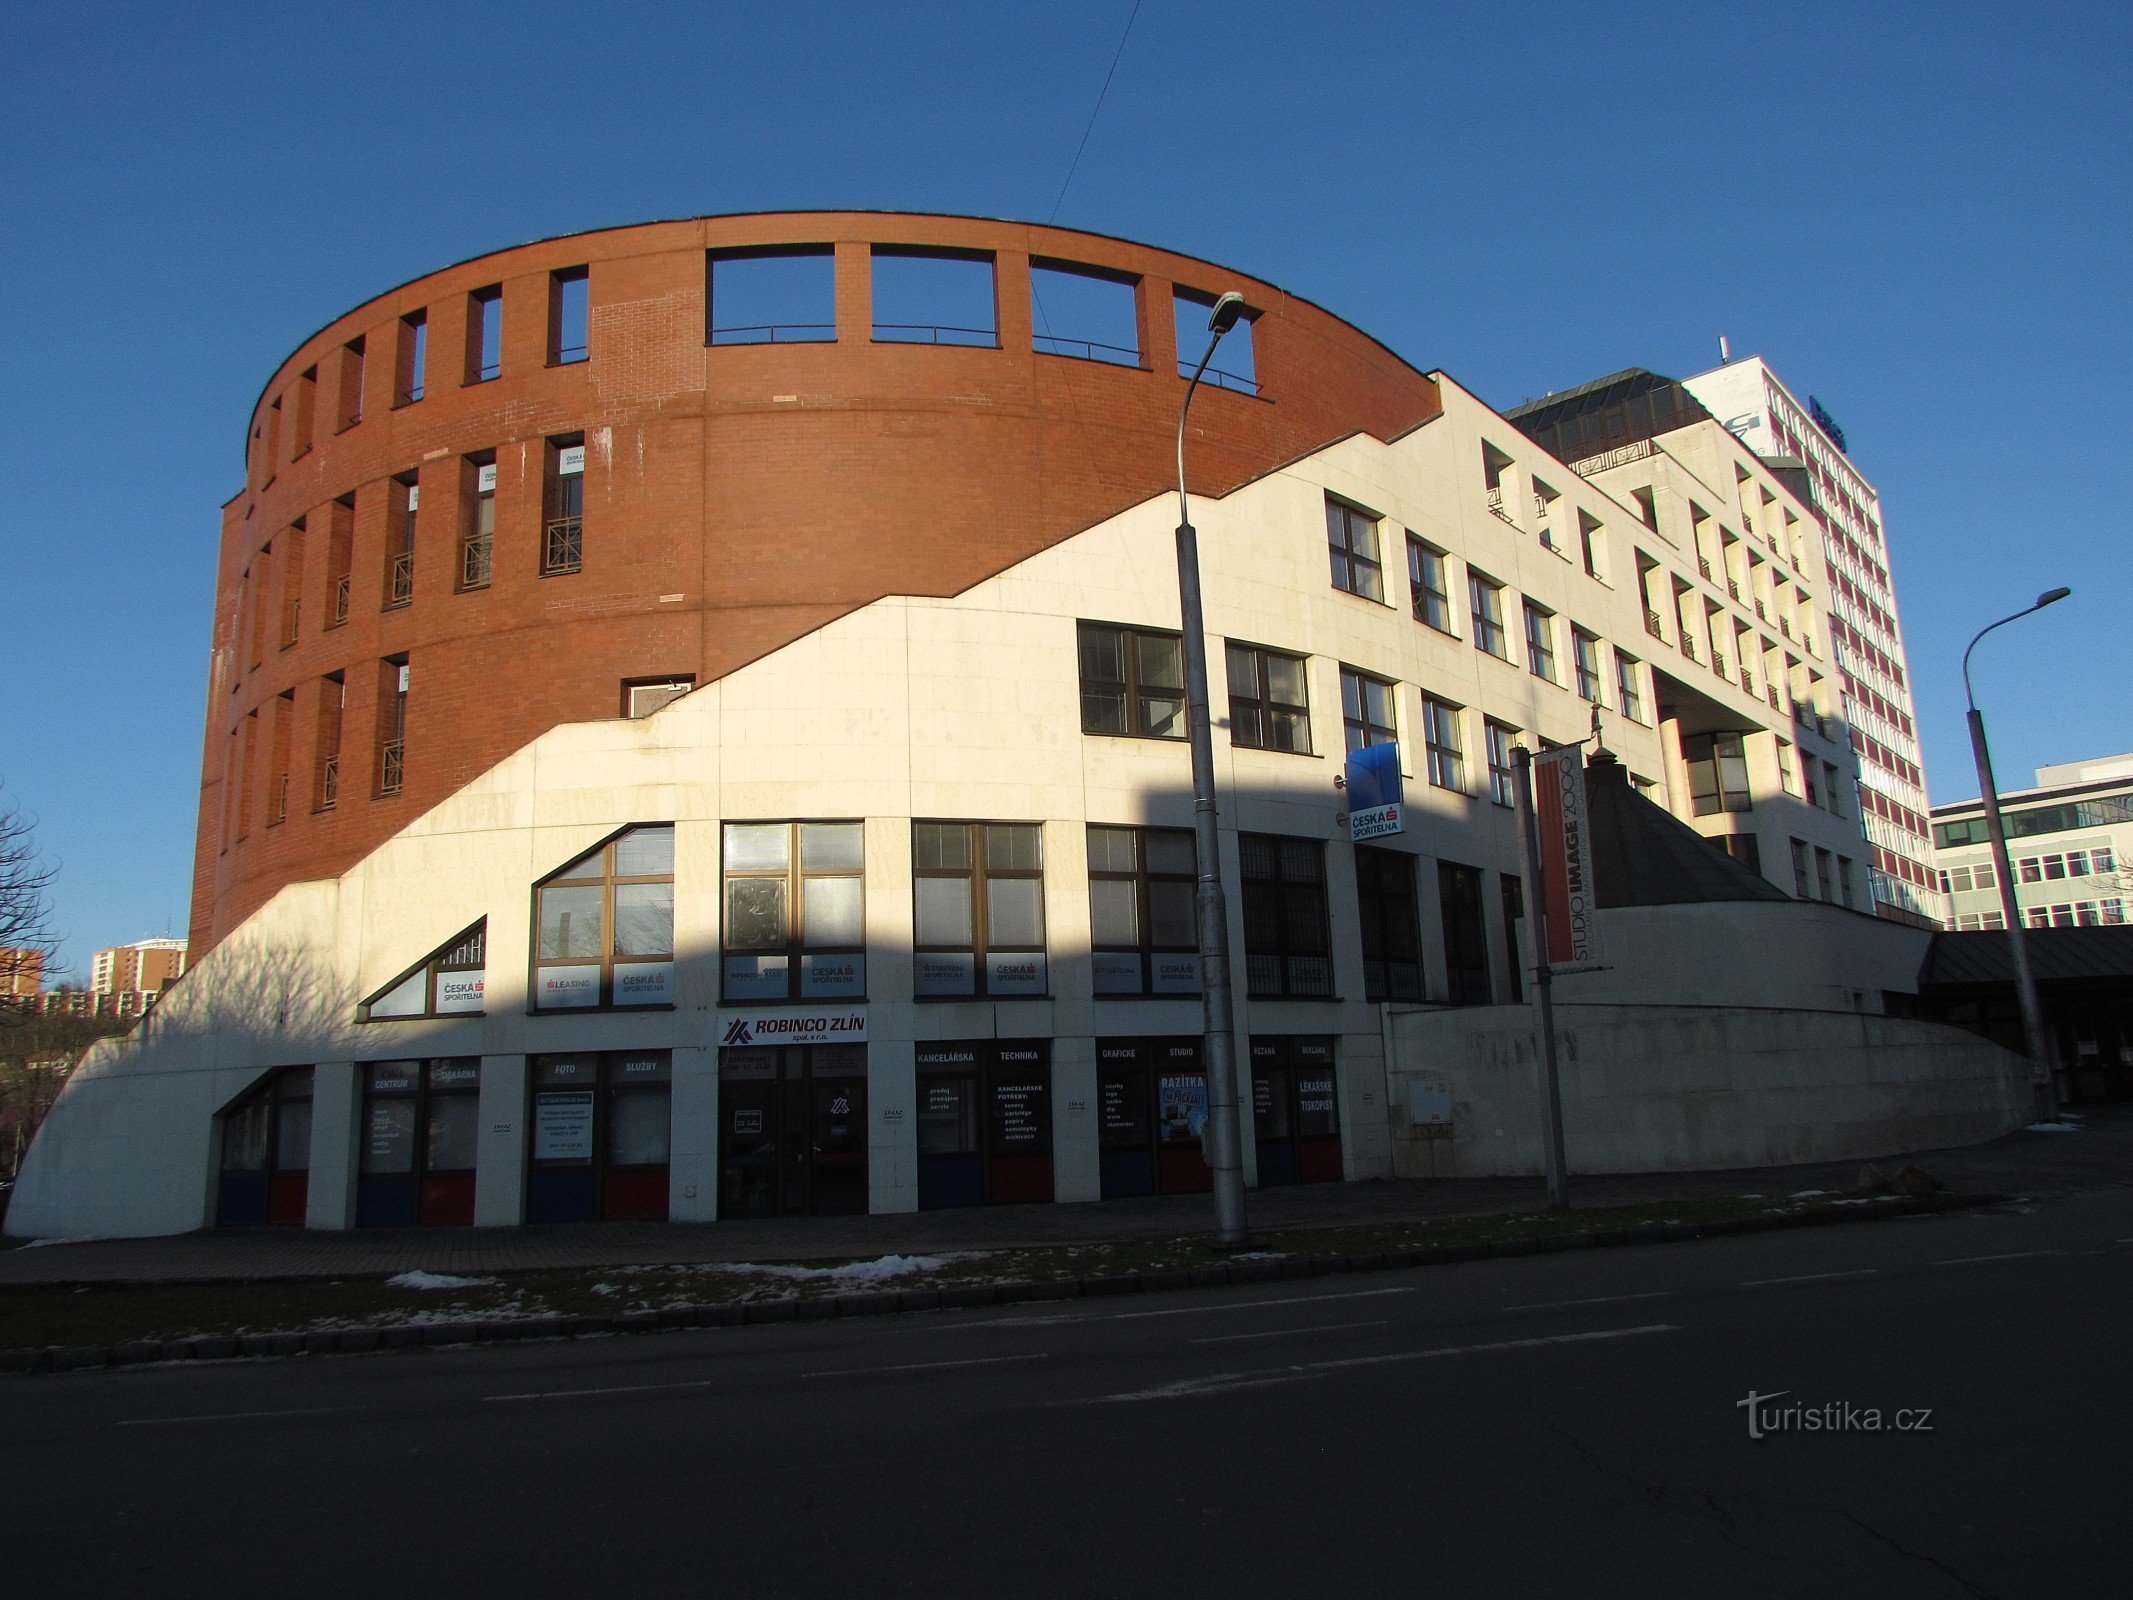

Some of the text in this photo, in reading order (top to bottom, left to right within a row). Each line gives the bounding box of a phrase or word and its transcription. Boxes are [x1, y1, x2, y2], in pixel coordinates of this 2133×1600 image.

[1352, 812, 1386, 828] ČESKÁ
[1353, 822, 1398, 838] SPOŘITELNA
[1559, 755, 1588, 962] STUDIO IMAGE 2000
[812, 966, 843, 976] ČESKÁ
[997, 964, 1026, 974] ČESKÁ
[555, 979, 590, 989] LEASING
[623, 974, 655, 985] ČESKÁ
[812, 976, 854, 984] SPOŘITELNA
[444, 982, 474, 993] ČESKÁ
[623, 985, 664, 993] SPOŘITELNA
[444, 993, 483, 1002] SPOŘITELNA
[755, 1013, 865, 1034] ROBINCO ZLÍN
[918, 1051, 1038, 1063] KANCELÁŘSKÁ TECHNIKA
[1169, 1047, 1194, 1056] STUDIO
[555, 1060, 657, 1074] FOTO SLUŽBY
[375, 1079, 408, 1089] CENTRUM
[1161, 1074, 1204, 1088] RAZÍTKA
[1300, 1099, 1333, 1112] TISKOPISY
